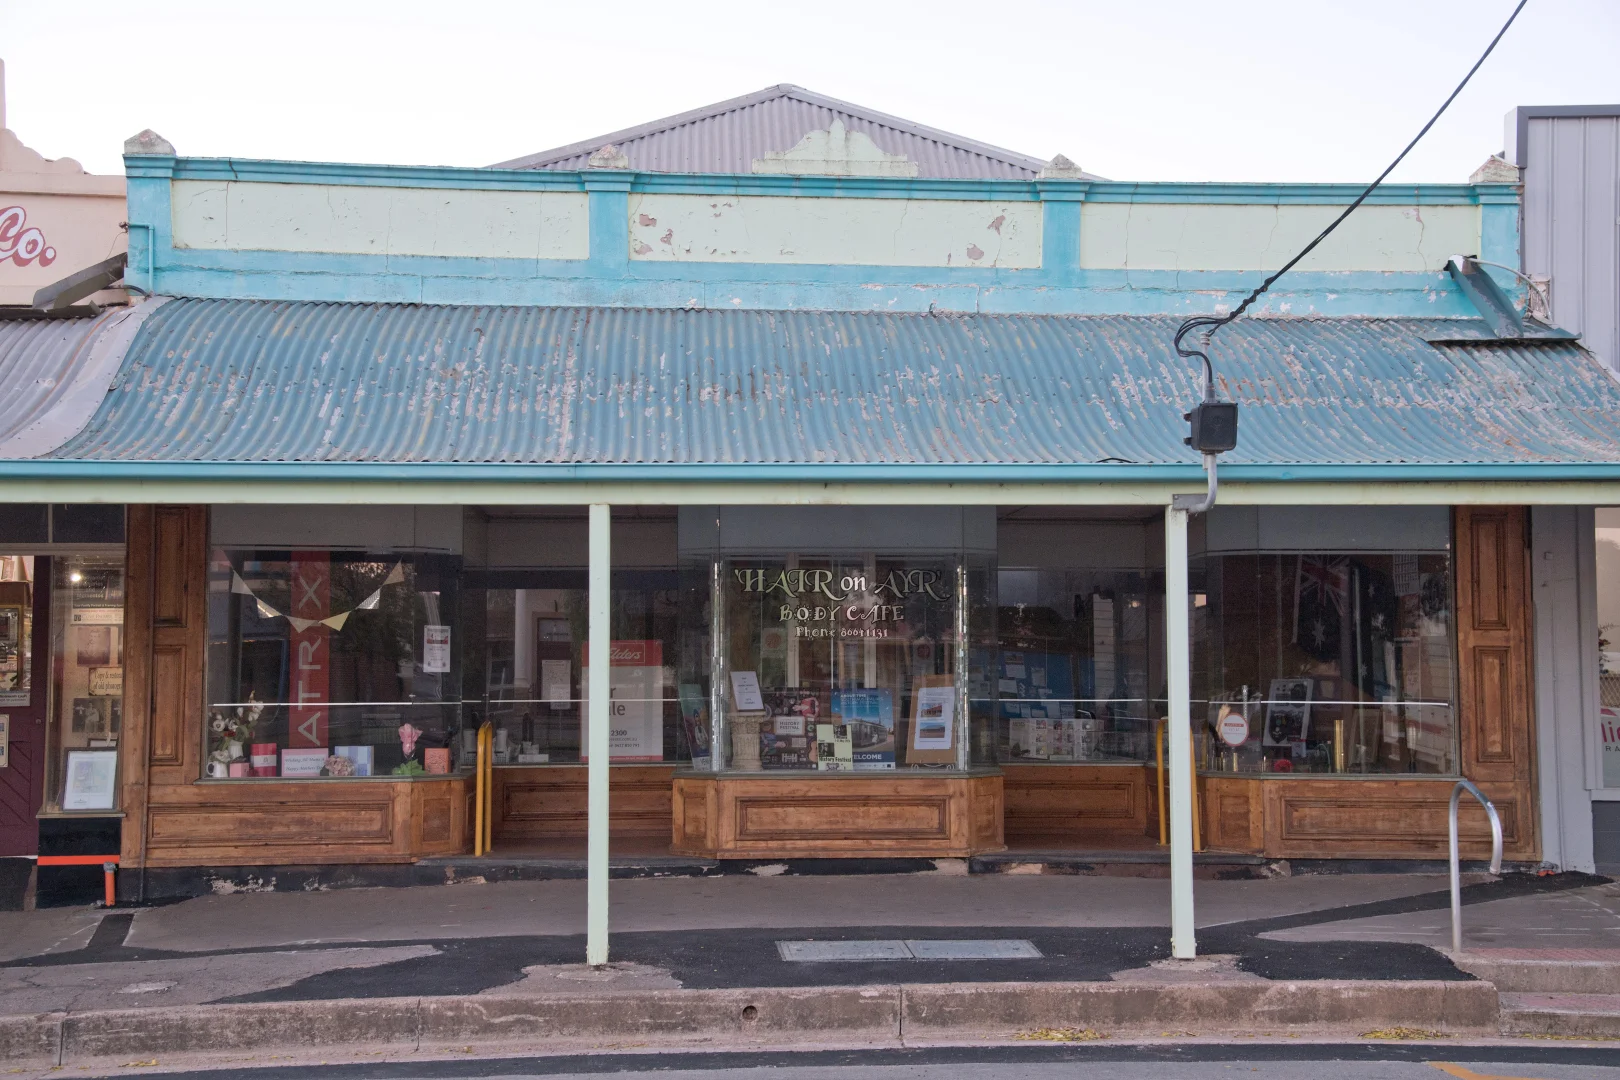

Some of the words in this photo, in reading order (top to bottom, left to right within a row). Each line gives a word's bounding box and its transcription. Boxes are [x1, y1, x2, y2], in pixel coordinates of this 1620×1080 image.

[840, 576, 867, 591] on
[779, 603, 841, 623] BODY
[846, 604, 905, 624] CAFE
[794, 626, 836, 640] Phone
